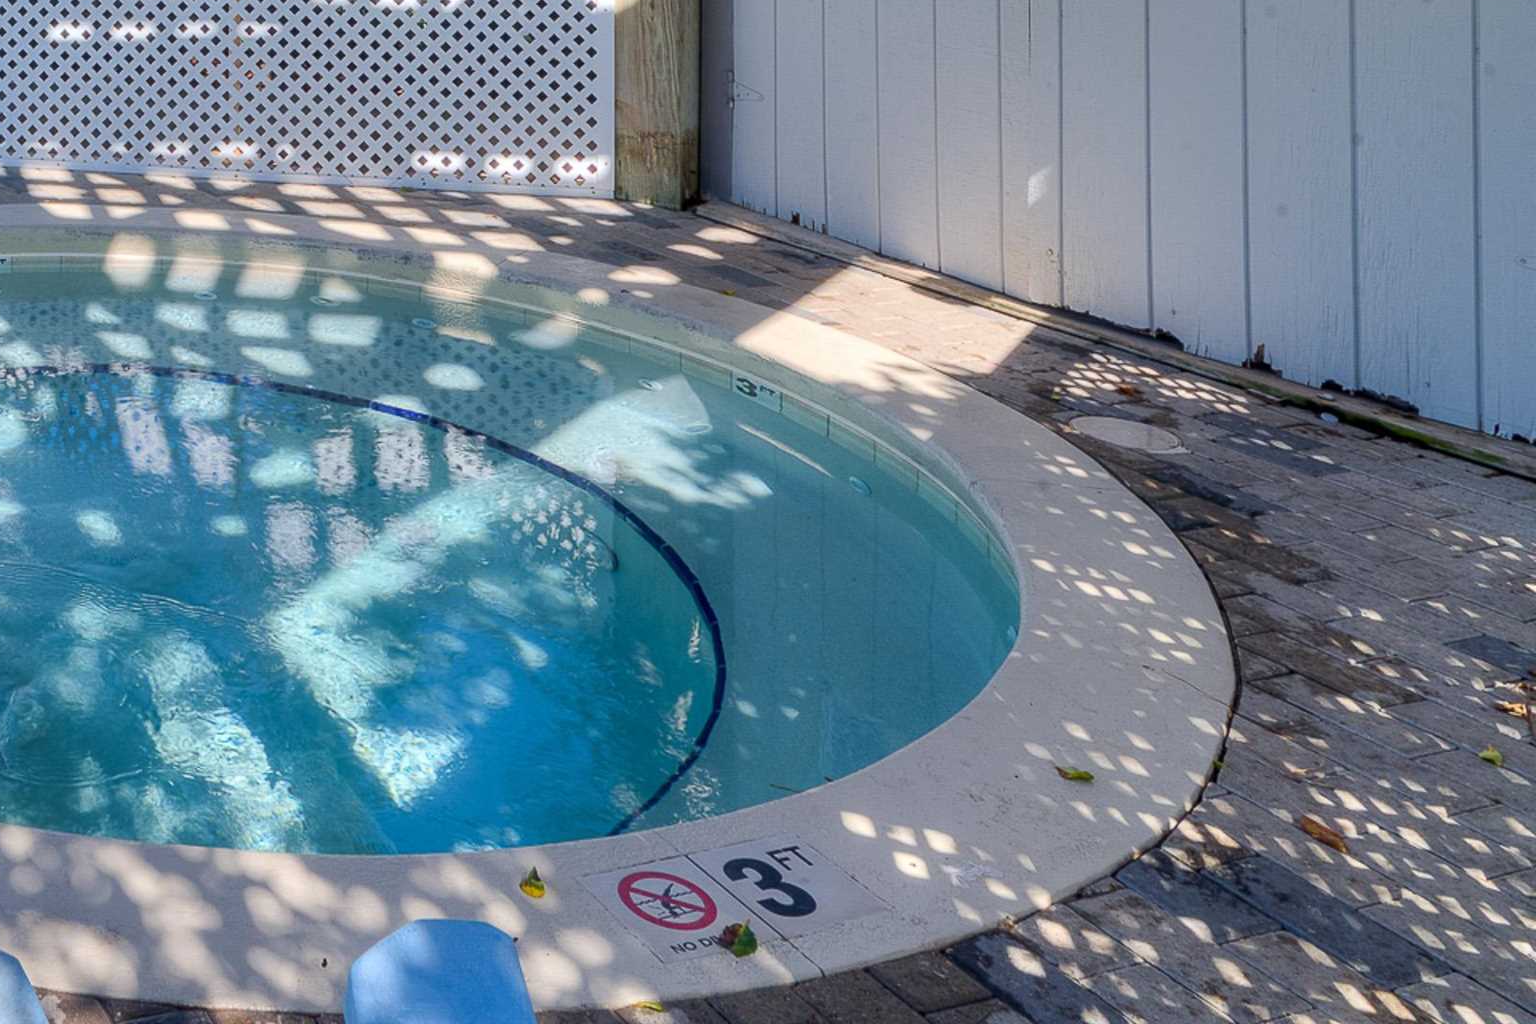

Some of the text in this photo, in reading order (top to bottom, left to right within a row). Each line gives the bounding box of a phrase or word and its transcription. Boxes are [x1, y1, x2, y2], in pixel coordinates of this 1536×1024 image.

[735, 377, 758, 397] 3
[723, 845, 817, 917] 3 FT
[670, 941, 697, 954] NO
